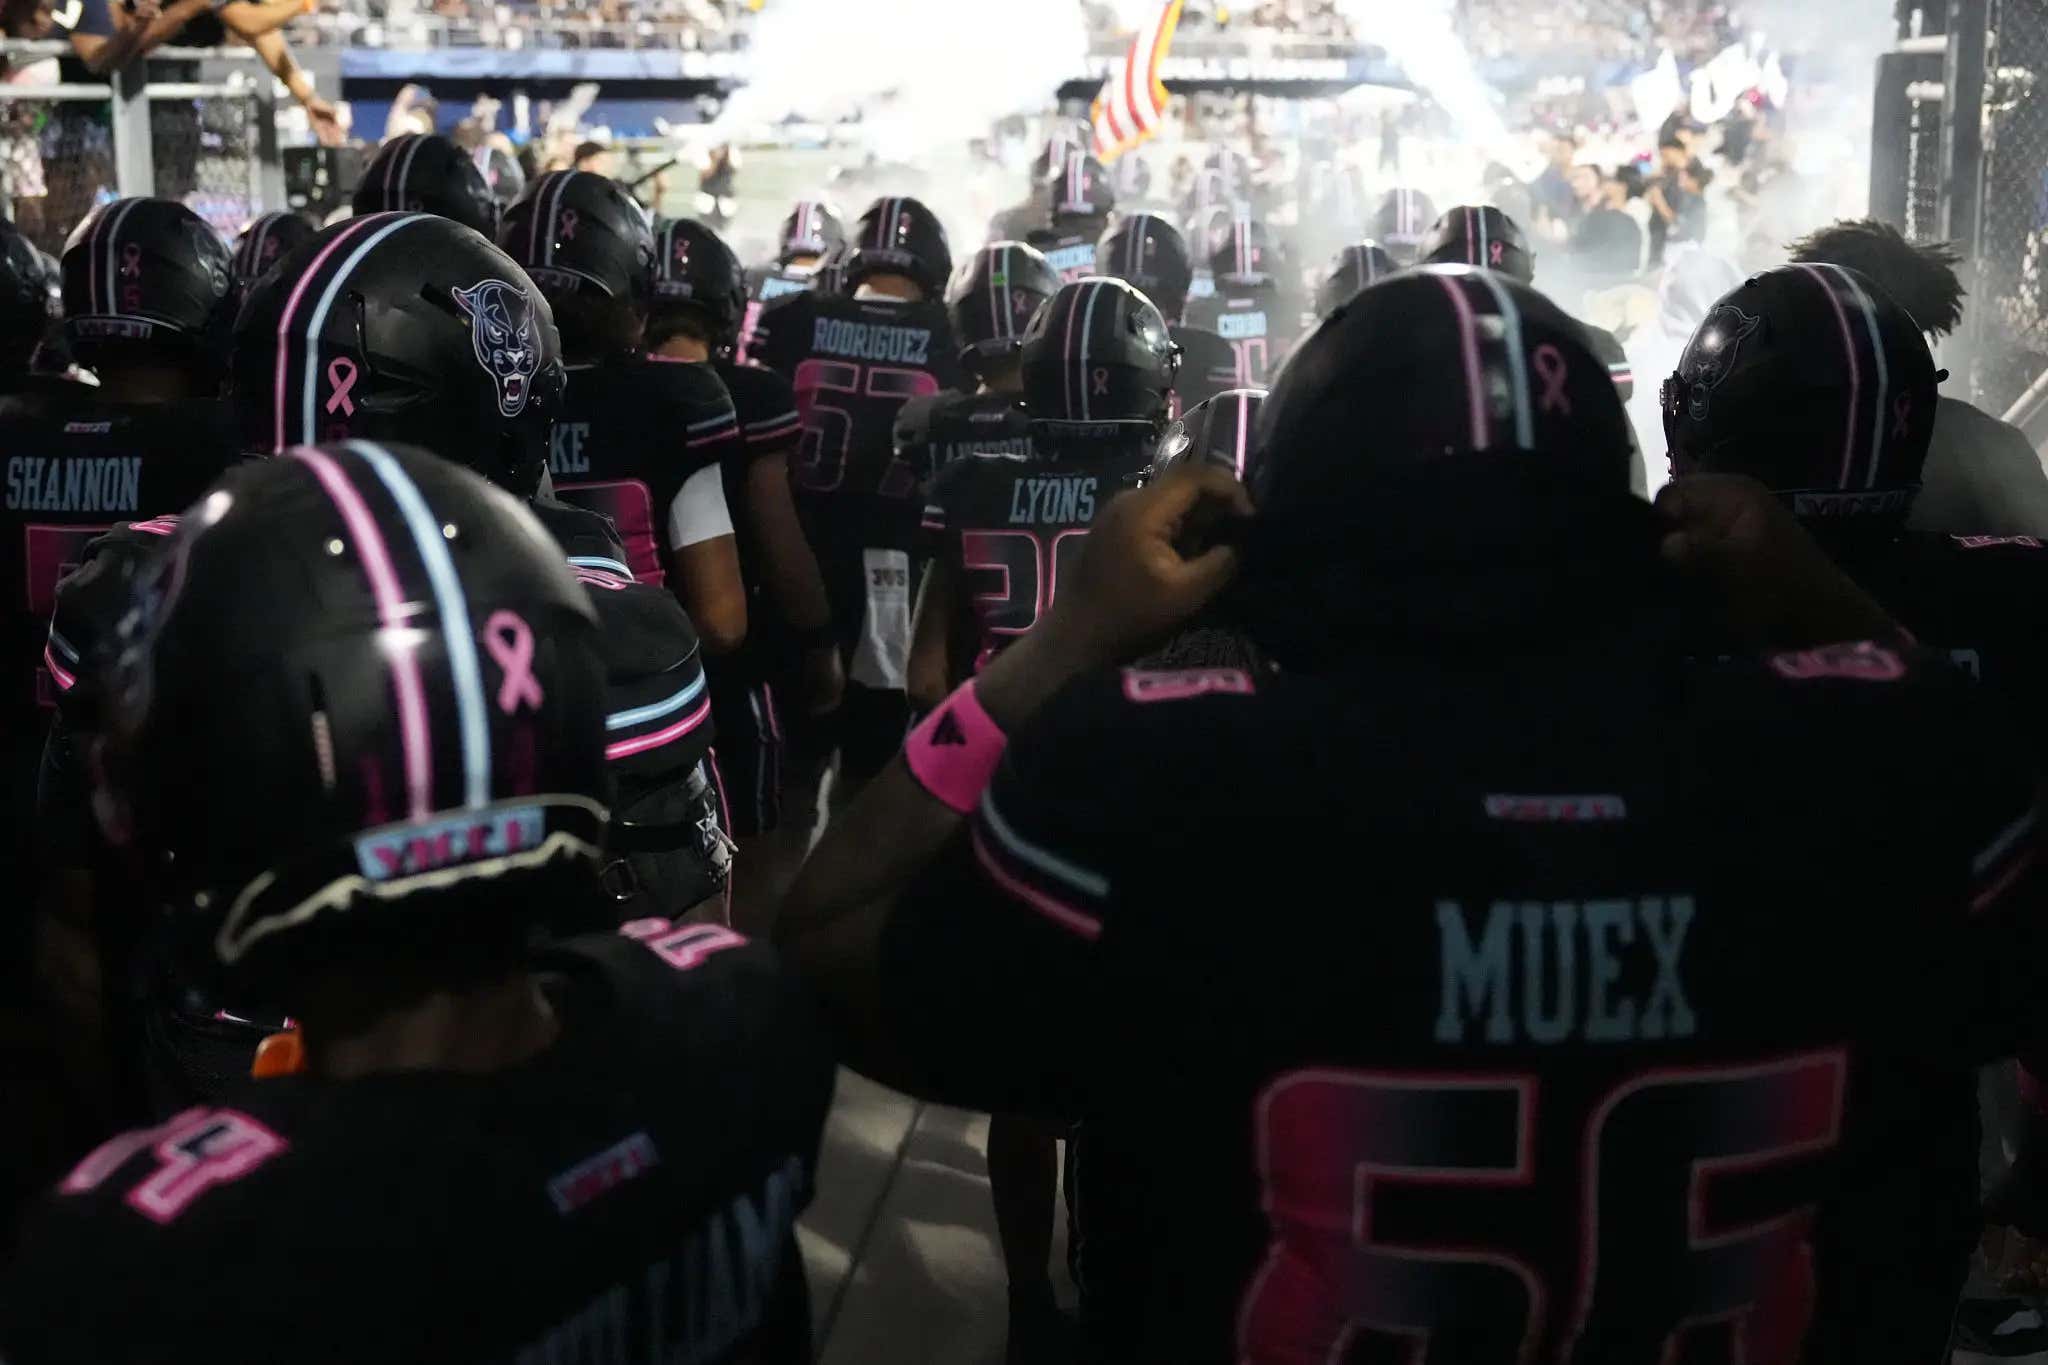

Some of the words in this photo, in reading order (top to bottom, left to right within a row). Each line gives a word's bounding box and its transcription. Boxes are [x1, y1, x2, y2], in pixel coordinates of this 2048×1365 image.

[811, 315, 932, 365] RODRIGUEZ
[4, 455, 143, 513] SHANNON
[1008, 476, 1098, 524] LYONS
[1432, 894, 1698, 1047] MUEX
